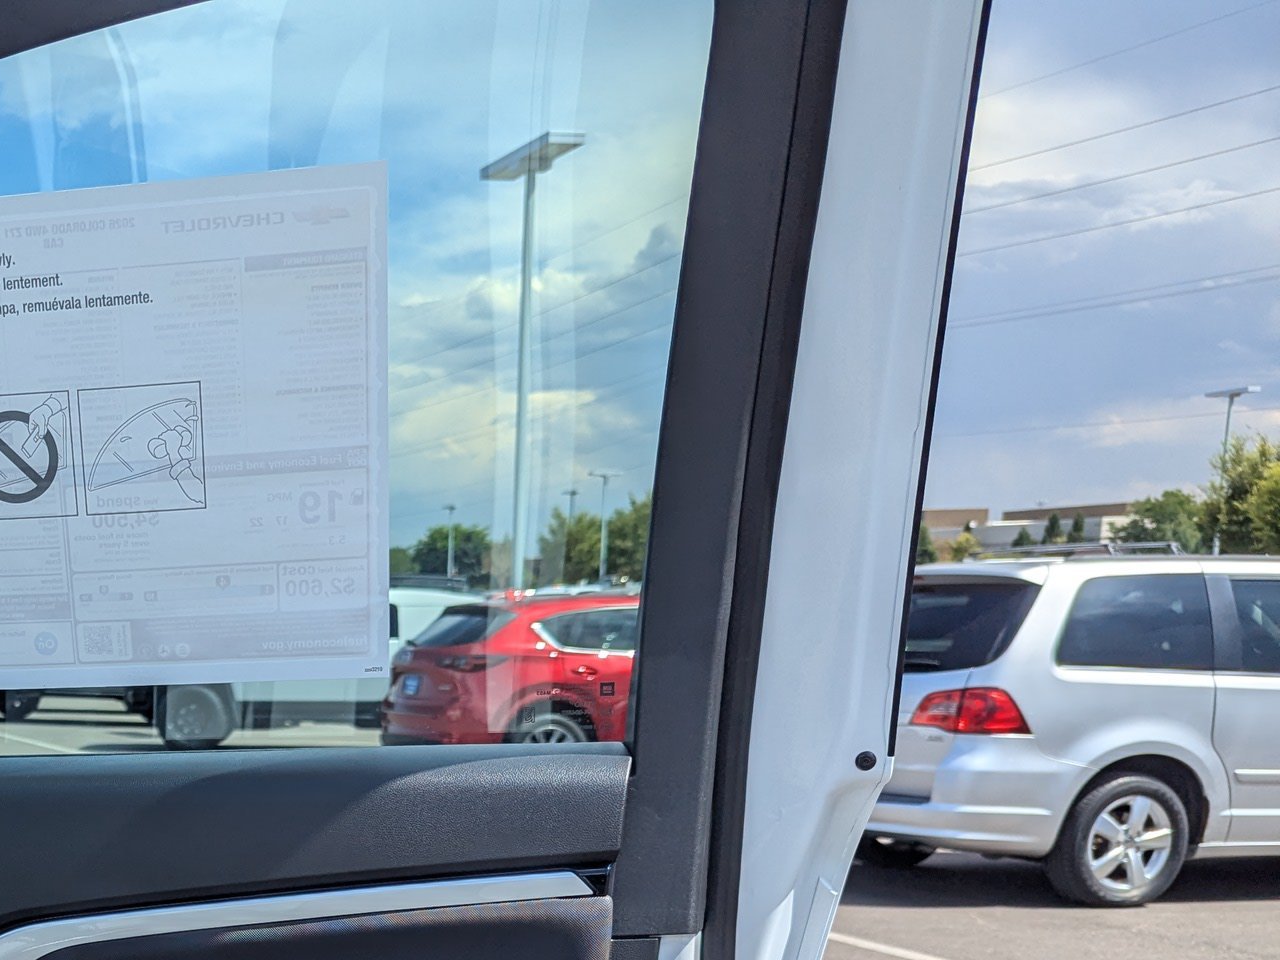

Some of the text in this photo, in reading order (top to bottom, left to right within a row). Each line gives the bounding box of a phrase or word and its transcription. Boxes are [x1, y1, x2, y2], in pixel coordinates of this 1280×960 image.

[3, 273, 63, 291] lentement.
[22, 296, 82, 313] remuévala
[85, 291, 153, 308] lentamente.
